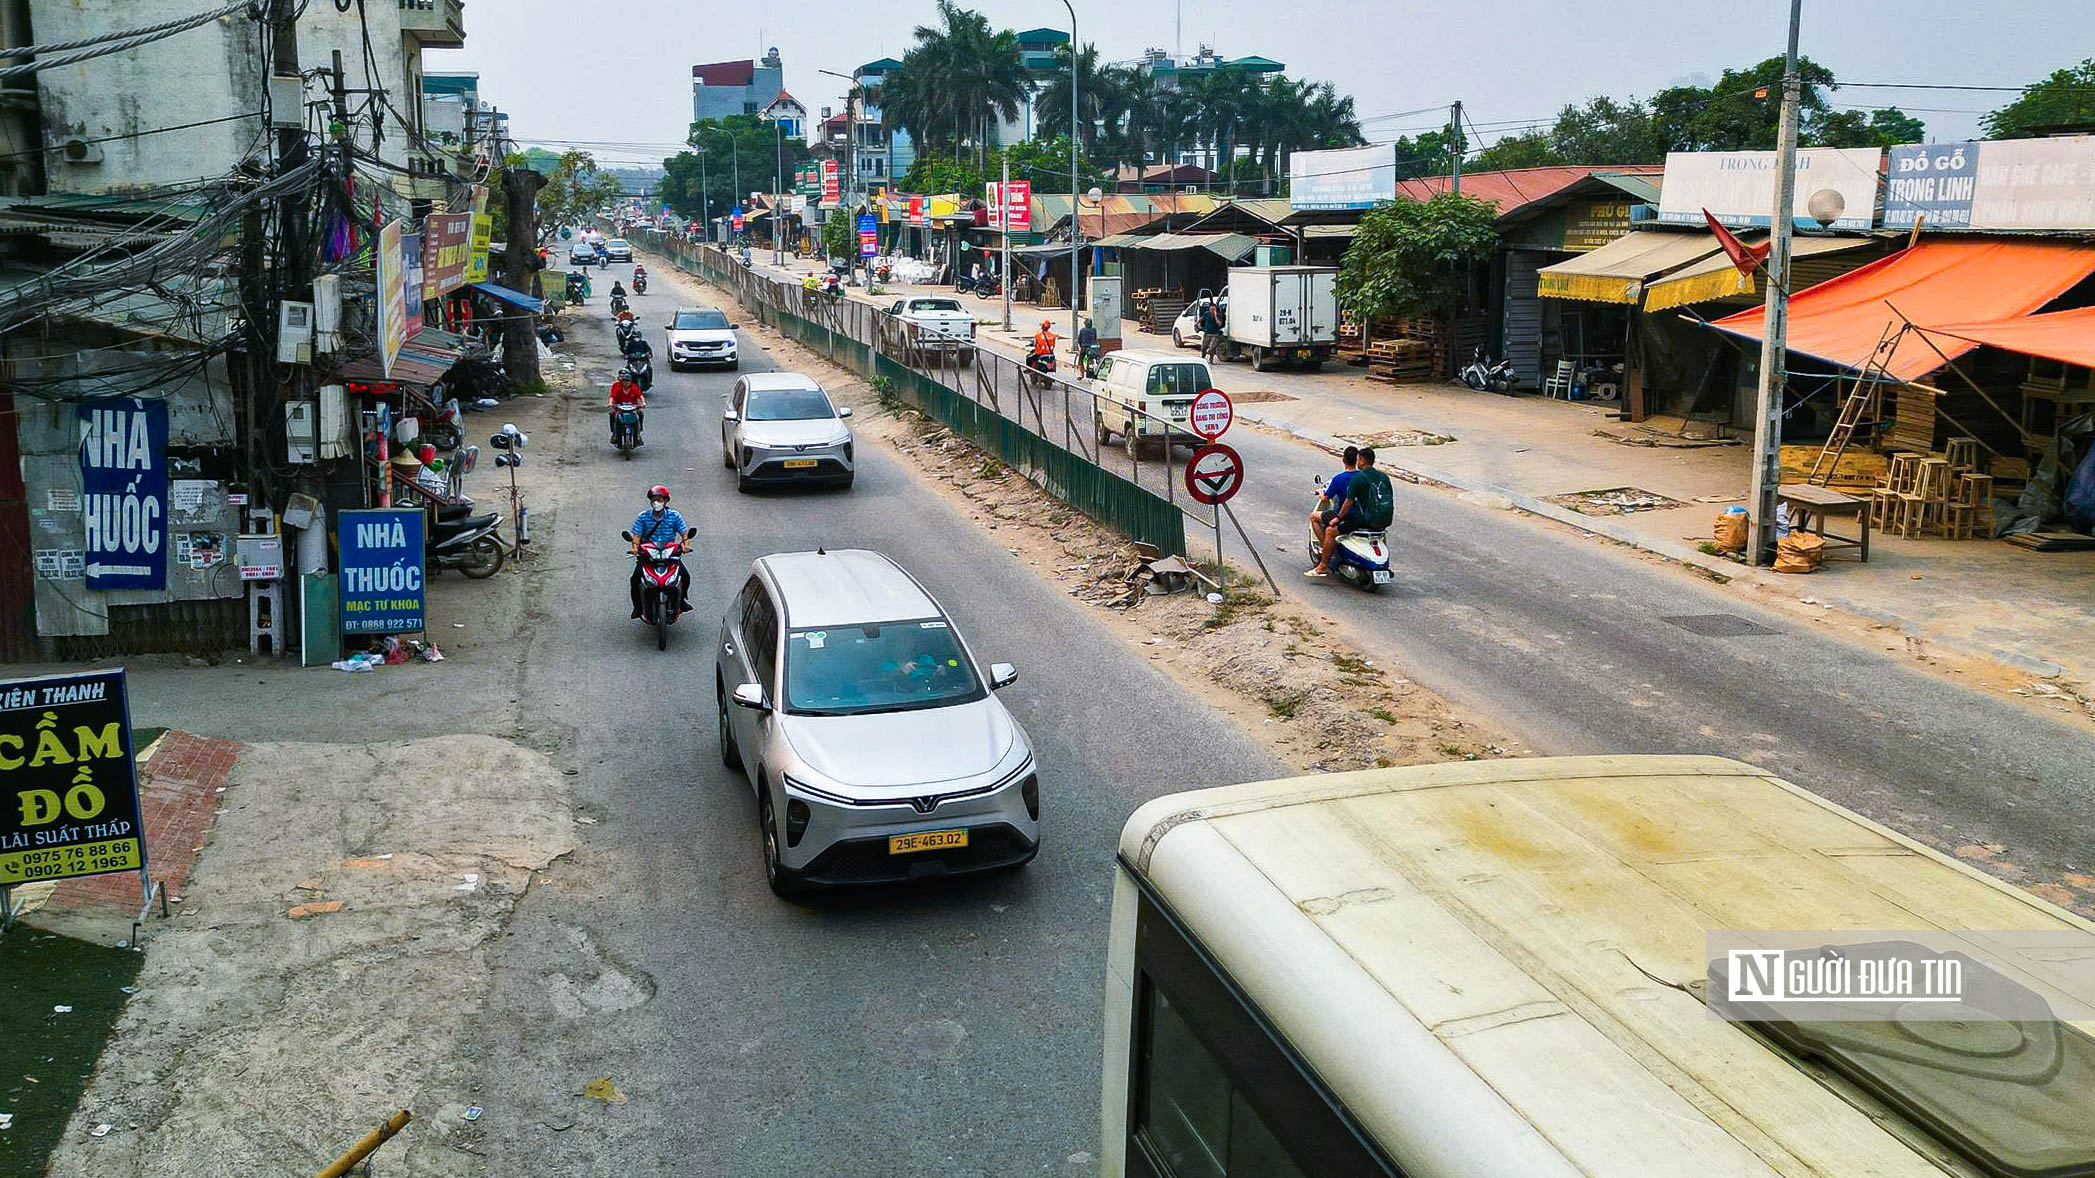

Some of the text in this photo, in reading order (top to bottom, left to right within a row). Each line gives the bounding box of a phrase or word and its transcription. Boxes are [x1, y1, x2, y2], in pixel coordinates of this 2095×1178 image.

[1899, 148, 1966, 172] ĐỒ GỖ
[1889, 176, 1974, 206] TRỌNG LINH
[82, 398, 152, 470] NHÀ
[357, 517, 406, 549] NHÀ
[344, 557, 421, 592] THUỐC
[346, 600, 372, 614] MẠC
[391, 599, 420, 611] KHOA
[345, 620, 360, 630] ĐT:
[387, 619, 404, 629] 922
[406, 618, 423, 628] 571
[42, 681, 105, 704] THANH
[0, 711, 124, 771] CẦM
[17, 765, 106, 826] ĐỒ
[1, 818, 131, 849] LÃI SUẤT THẤP
[896, 833, 961, 850] 29E-463.02
[23, 841, 131, 865] 0975 76 88 66
[24, 855, 128, 878] 0902 12 1963
